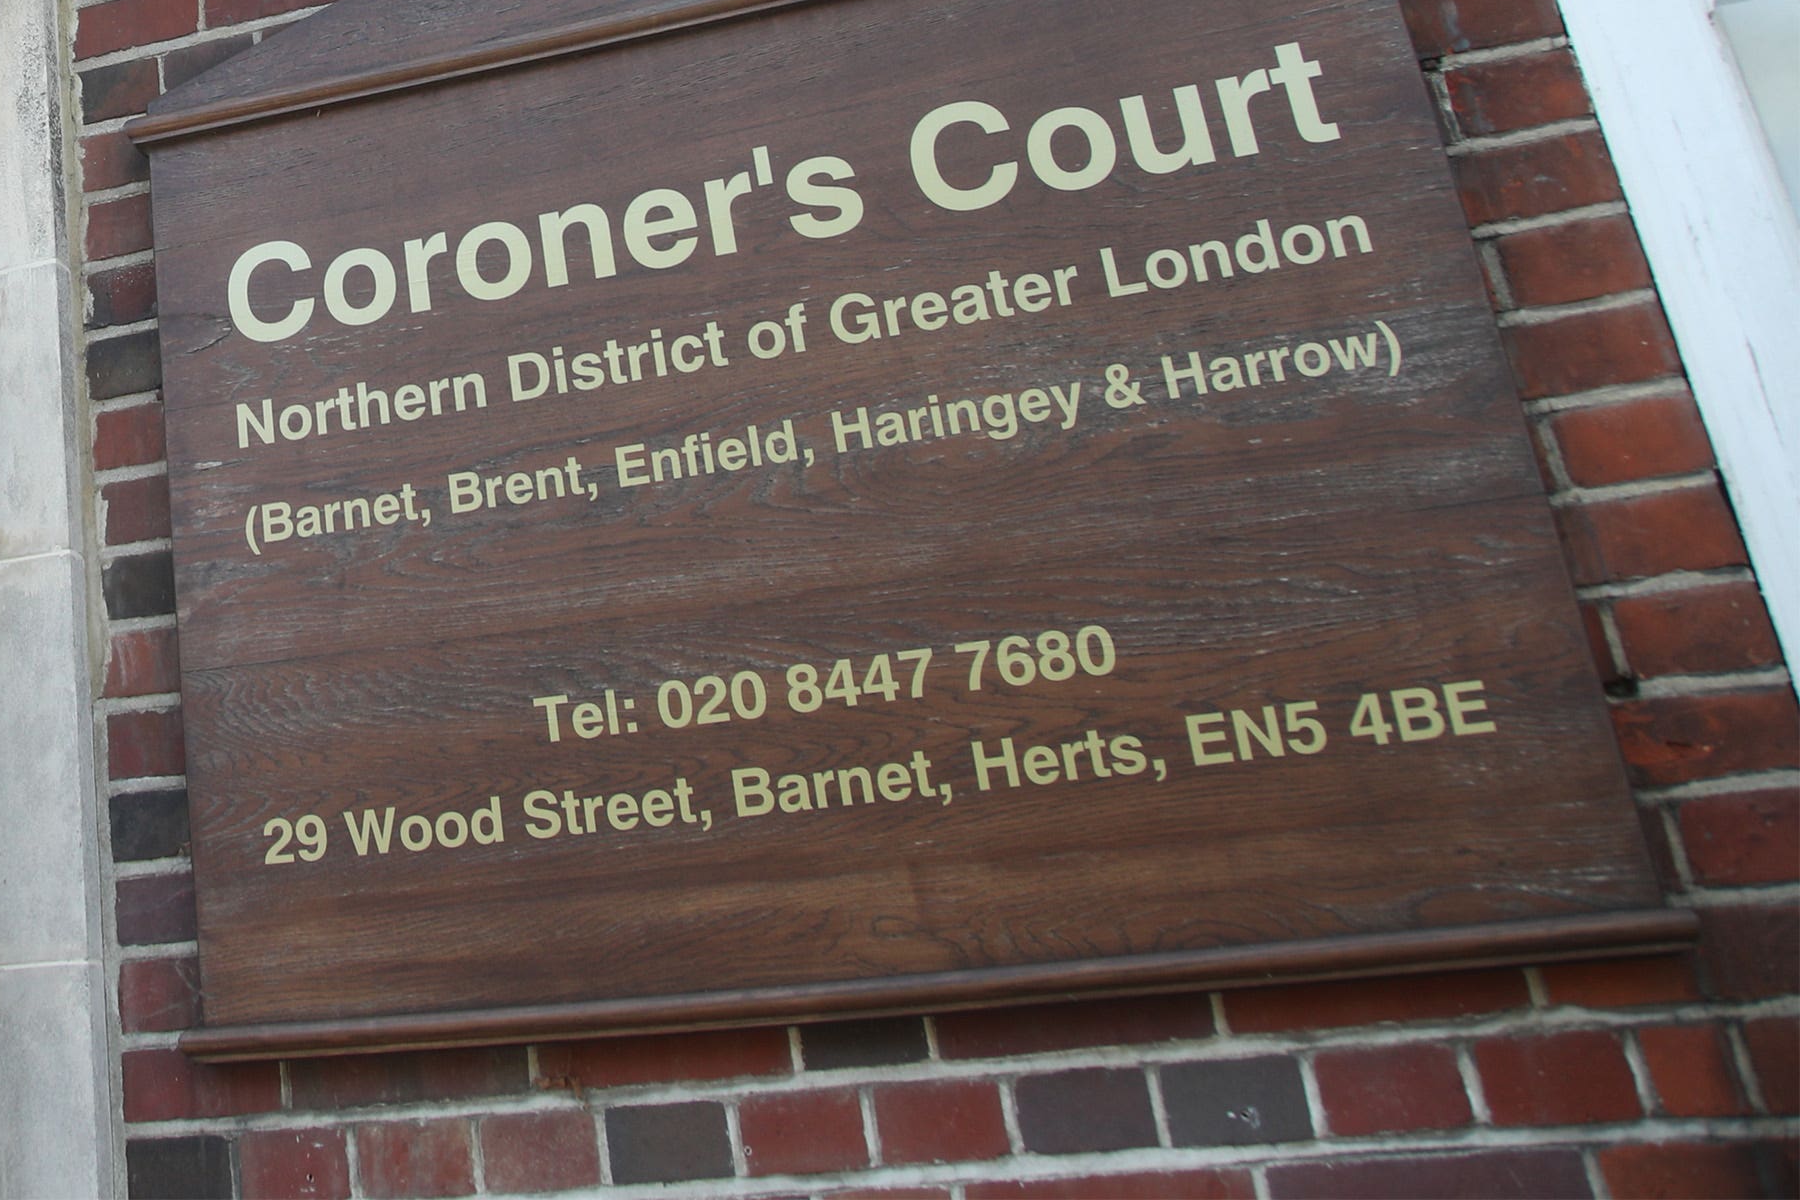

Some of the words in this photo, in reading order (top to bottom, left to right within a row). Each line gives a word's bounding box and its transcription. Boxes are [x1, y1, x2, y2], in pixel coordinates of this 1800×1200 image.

[227, 144, 864, 342] Coroner's
[908, 41, 1340, 212] Court
[234, 371, 487, 450] Northern
[506, 319, 730, 402] District
[746, 302, 807, 360] of
[828, 262, 1078, 345] Greater
[1099, 214, 1373, 299] London
[244, 482, 432, 556] (Barnet,
[446, 455, 598, 515] Brent,
[613, 418, 816, 489] Enfield,
[830, 380, 1082, 454] Haringey
[1104, 362, 1146, 409] &
[1159, 319, 1402, 401] Harrow)
[262, 813, 329, 866] 29
[342, 794, 506, 857] Wood
[522, 776, 713, 840] Street,
[730, 749, 954, 819] Barnet,
[970, 727, 1168, 792] Herts,
[1184, 700, 1328, 767] EN5
[1349, 679, 1497, 746] 4BE
[531, 687, 639, 744] Tel:
[656, 670, 767, 730] 020
[785, 646, 934, 714] 8447
[953, 624, 1117, 692] 7680
